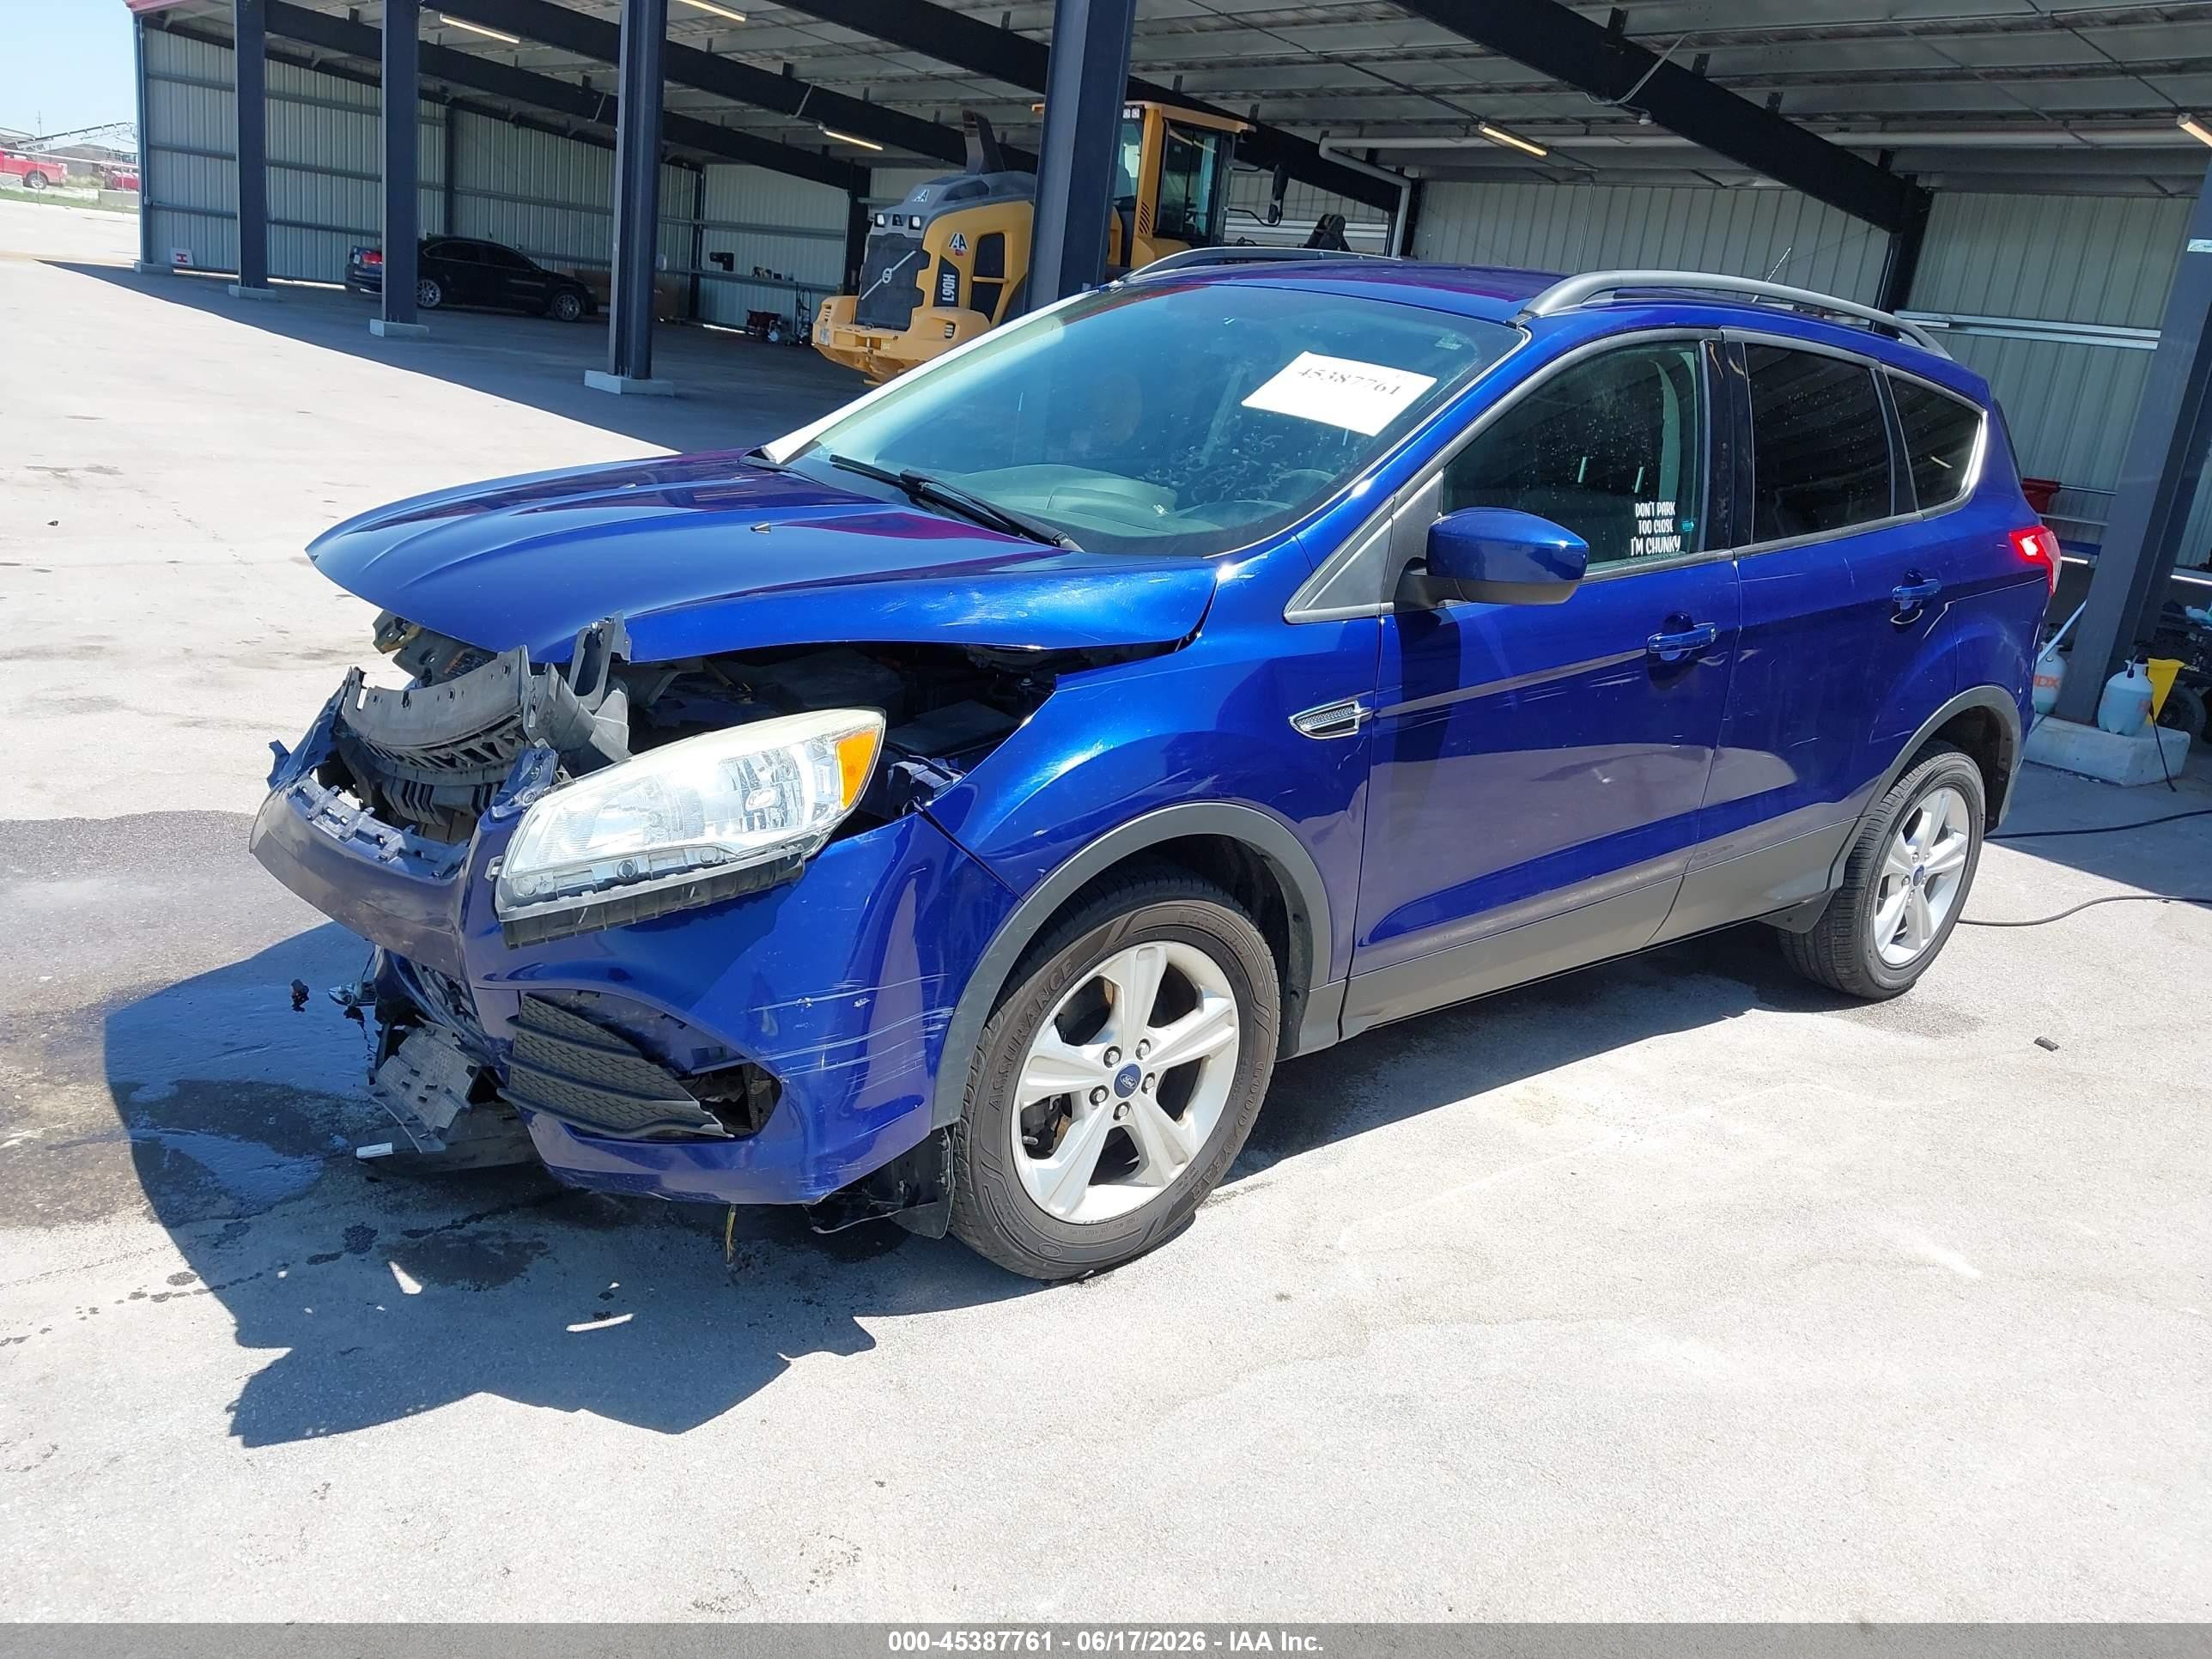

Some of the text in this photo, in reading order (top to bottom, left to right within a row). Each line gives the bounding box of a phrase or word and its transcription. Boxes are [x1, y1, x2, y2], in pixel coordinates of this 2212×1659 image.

[942, 274, 956, 302] L90H
[1297, 368, 1401, 395] 45387761
[1635, 501, 1675, 518] DON'T PARK
[1638, 519, 1674, 535] TOO CLOSE
[1631, 535, 1681, 556] I'M CHUNKY
[988, 958, 1073, 1111] ASSURANCE
[1121, 1074, 1135, 1088] Ford
